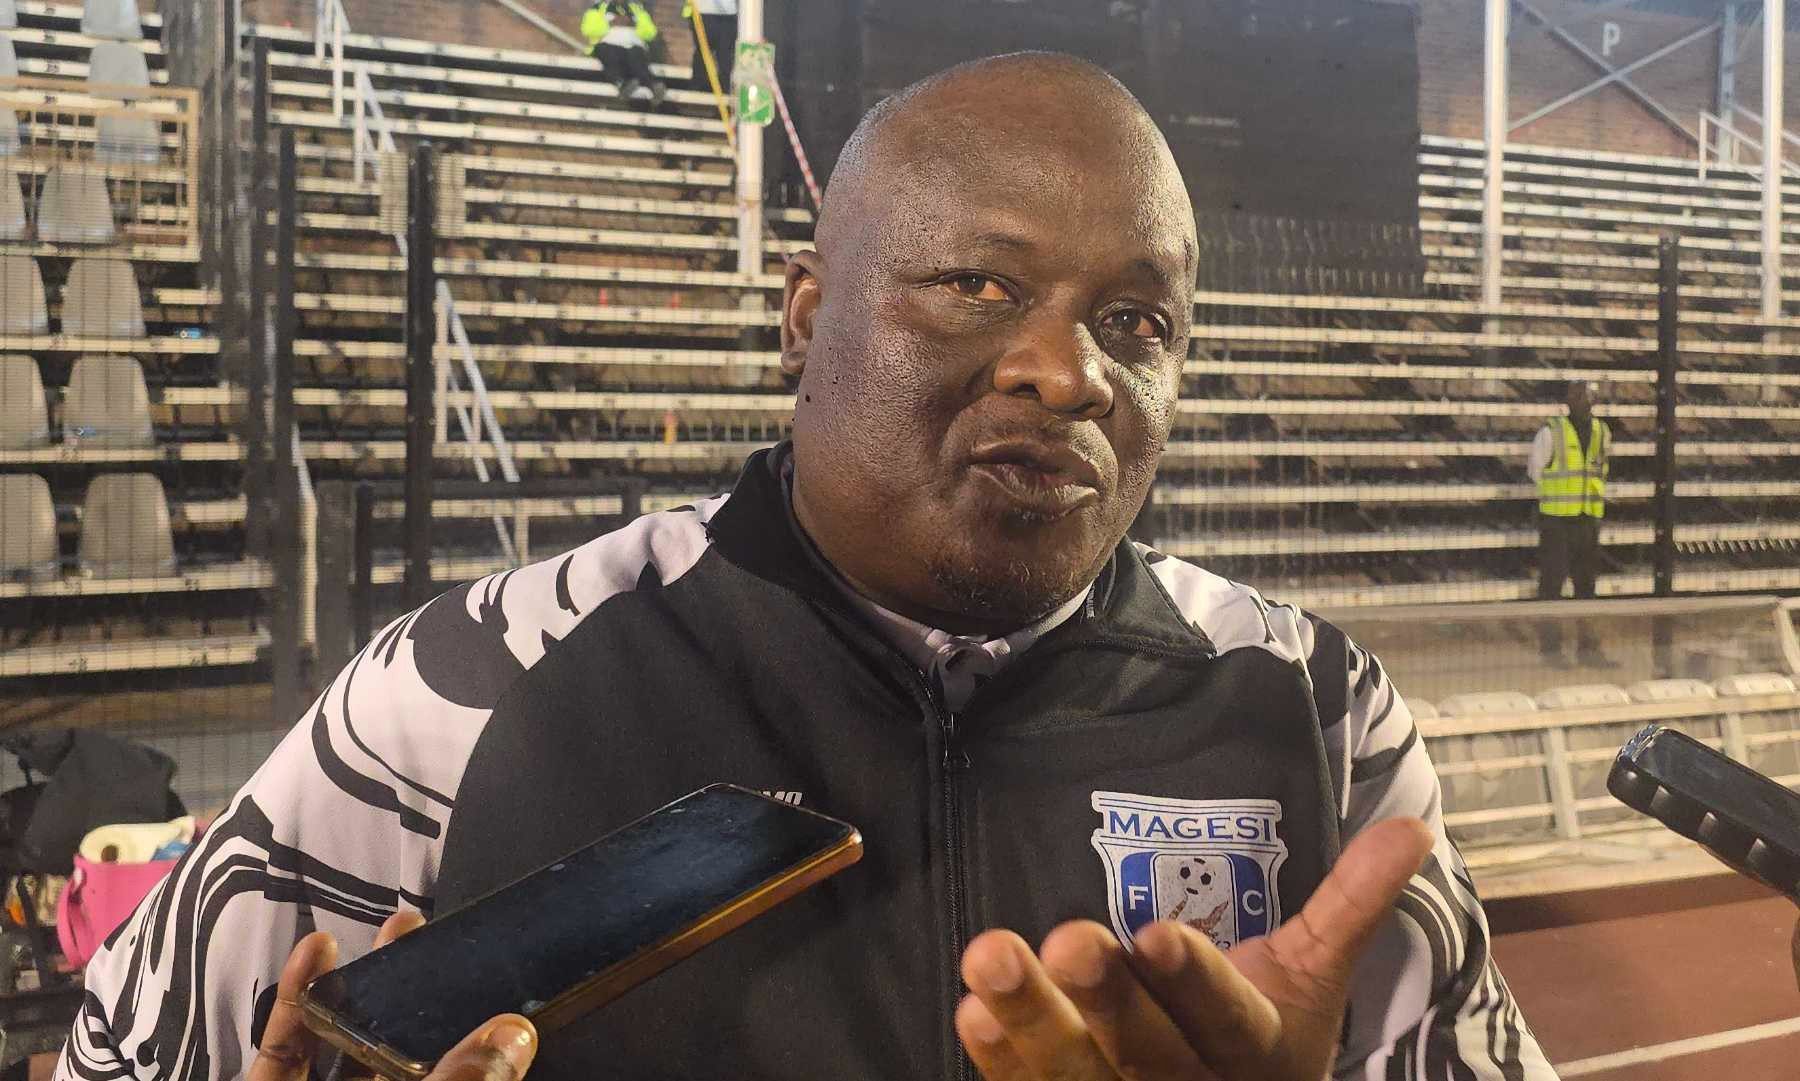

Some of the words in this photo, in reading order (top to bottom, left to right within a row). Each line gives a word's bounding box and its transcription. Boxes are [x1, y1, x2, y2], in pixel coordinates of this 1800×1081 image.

[1602, 21, 1621, 57] P
[1109, 810, 1272, 842] MAGESI
[1127, 883, 1149, 911] F
[1241, 889, 1265, 916] C
